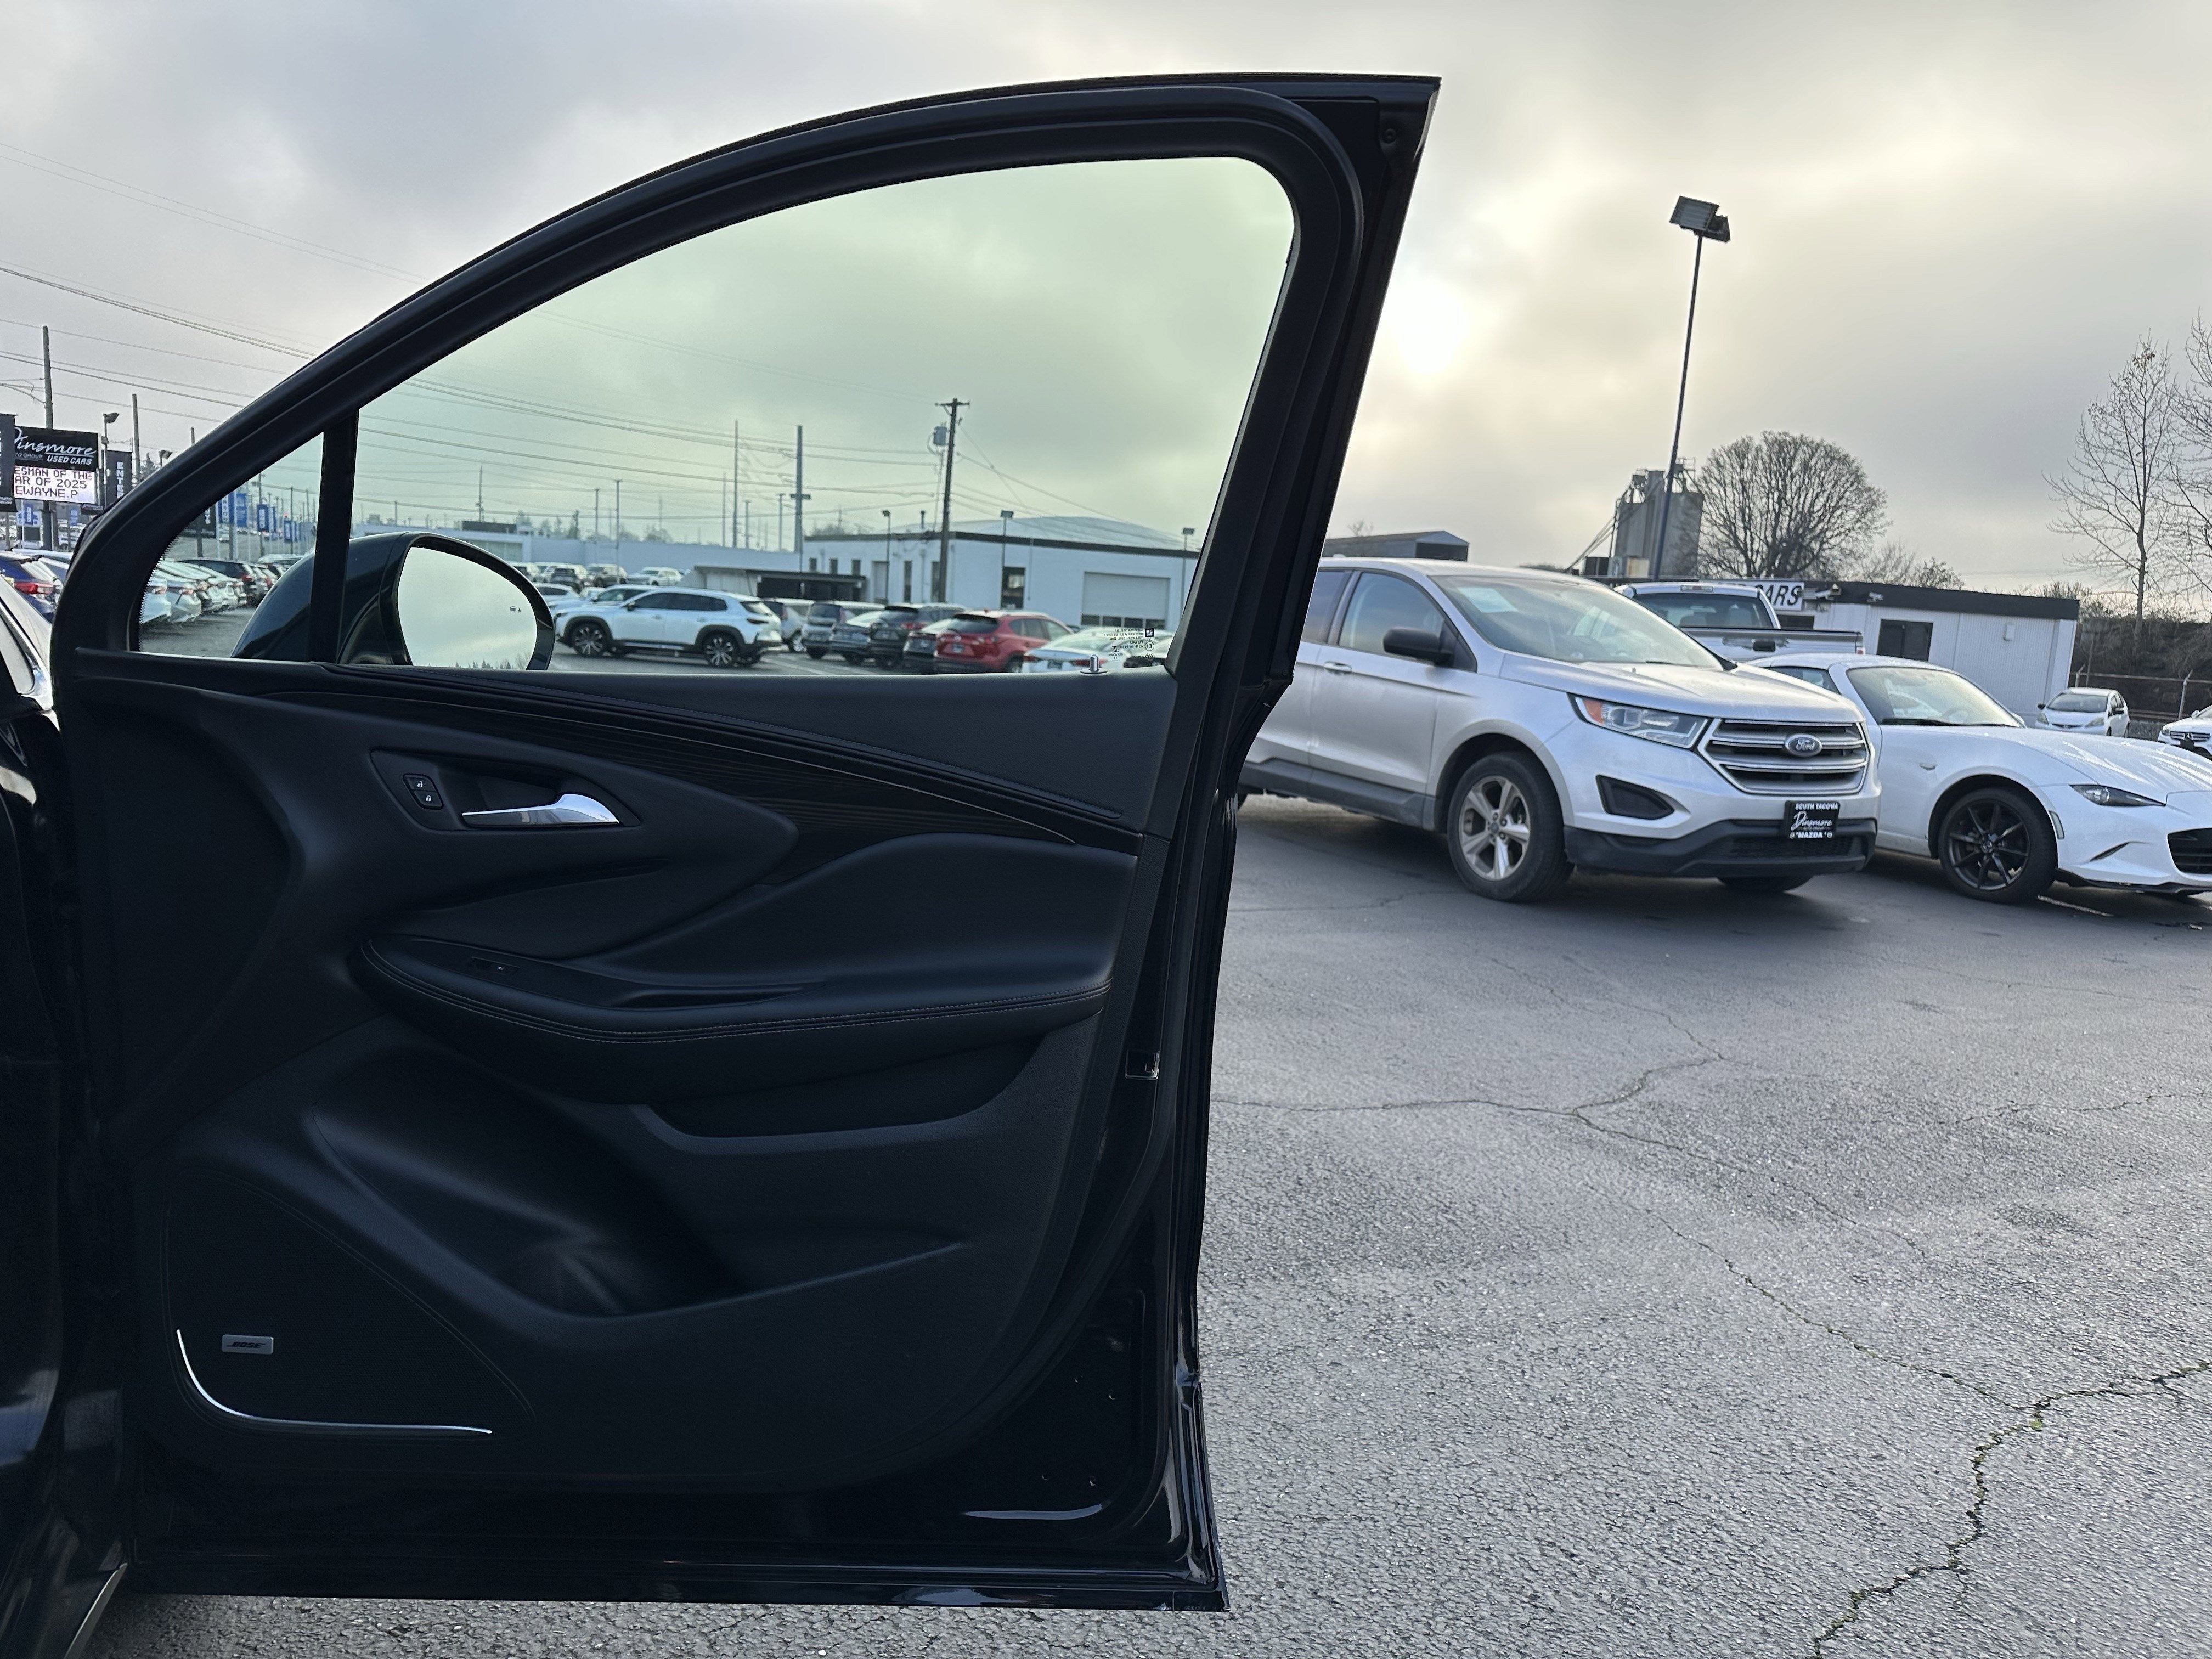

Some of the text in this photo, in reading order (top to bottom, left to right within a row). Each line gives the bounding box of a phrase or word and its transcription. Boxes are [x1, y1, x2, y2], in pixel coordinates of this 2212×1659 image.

[47, 455, 69, 464] USED
[15, 466, 92, 480] ESMAN OF THE
[15, 476, 87, 489] AR OF 2025
[1796, 738, 1815, 751] Ford
[1791, 811, 1832, 831] Dinsmore
